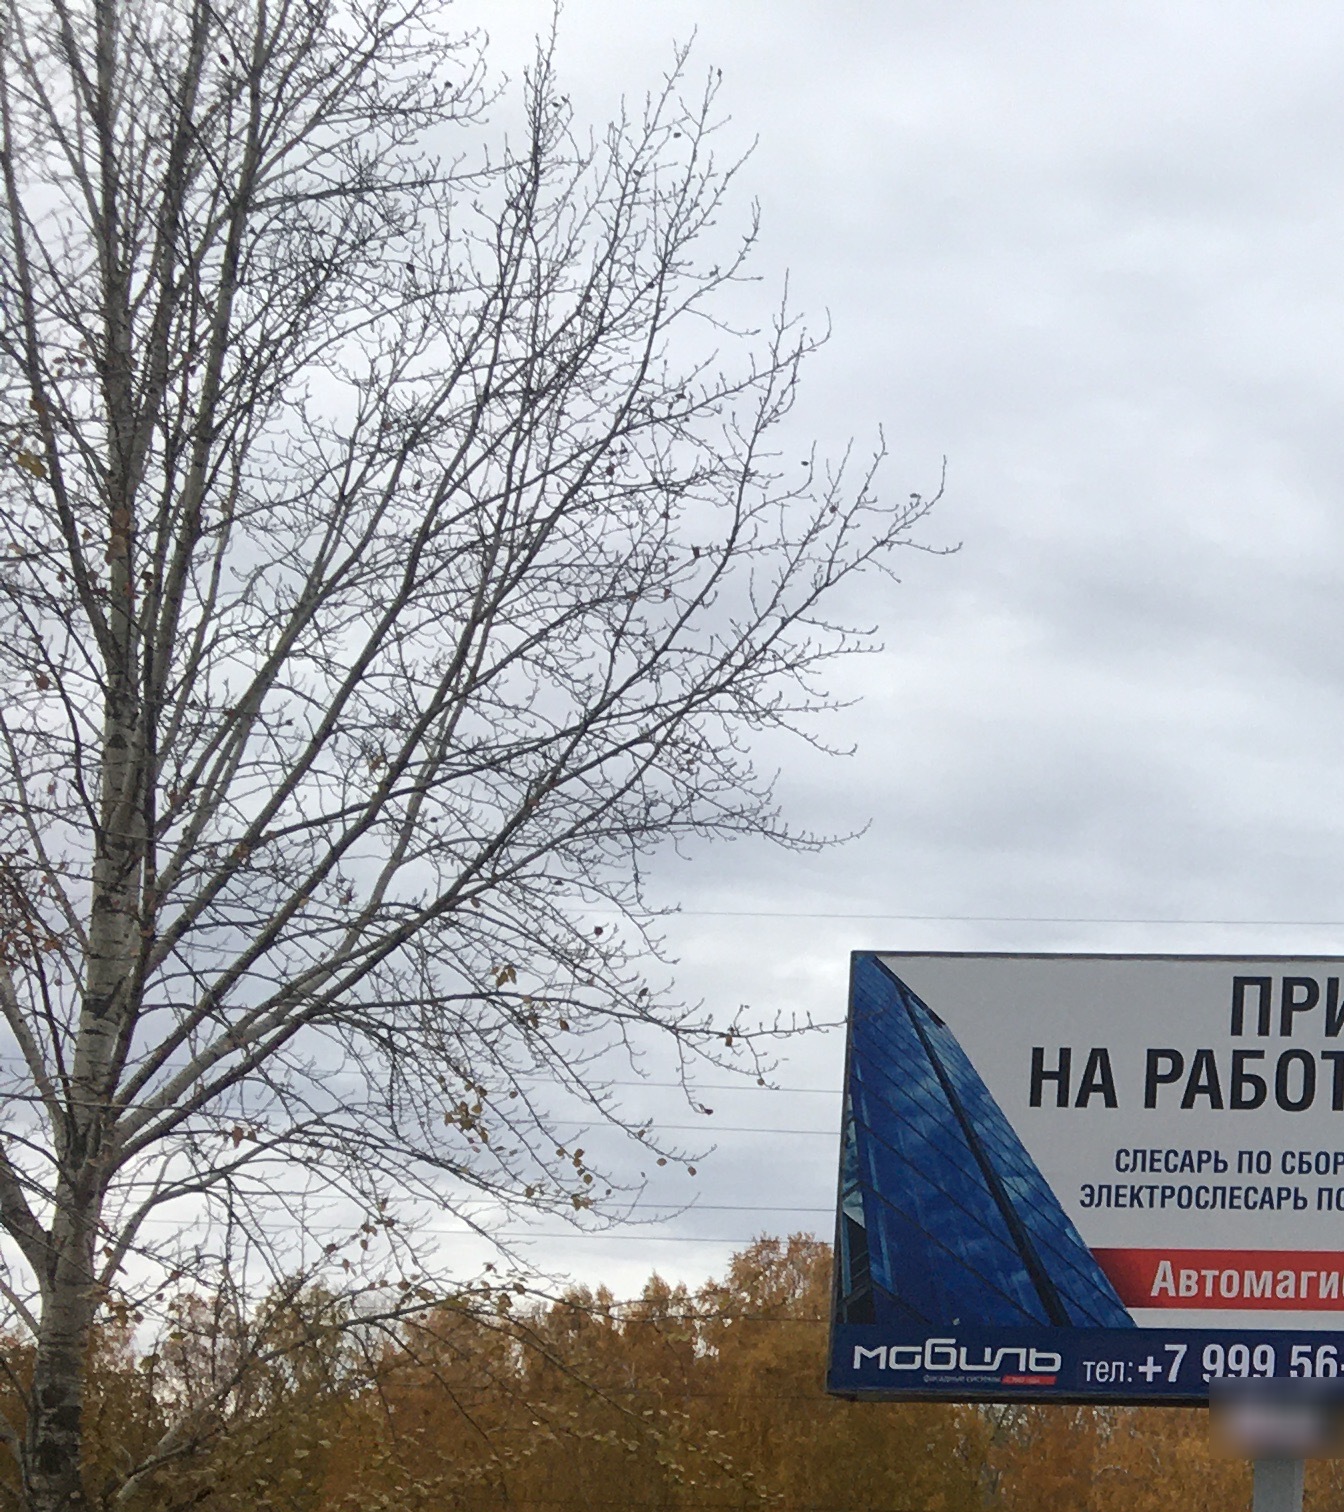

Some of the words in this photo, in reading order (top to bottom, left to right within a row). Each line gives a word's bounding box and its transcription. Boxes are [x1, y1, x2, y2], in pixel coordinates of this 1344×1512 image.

[1029, 1046, 1118, 1109] НА
[1114, 1148, 1229, 1174] СЛЕСАРЬ
[1236, 1150, 1272, 1174] ПО
[1079, 1183, 1309, 1211] ЭЛЕКТРОСЛЕСАРЬ
[1202, 1343, 1276, 1378] 999
